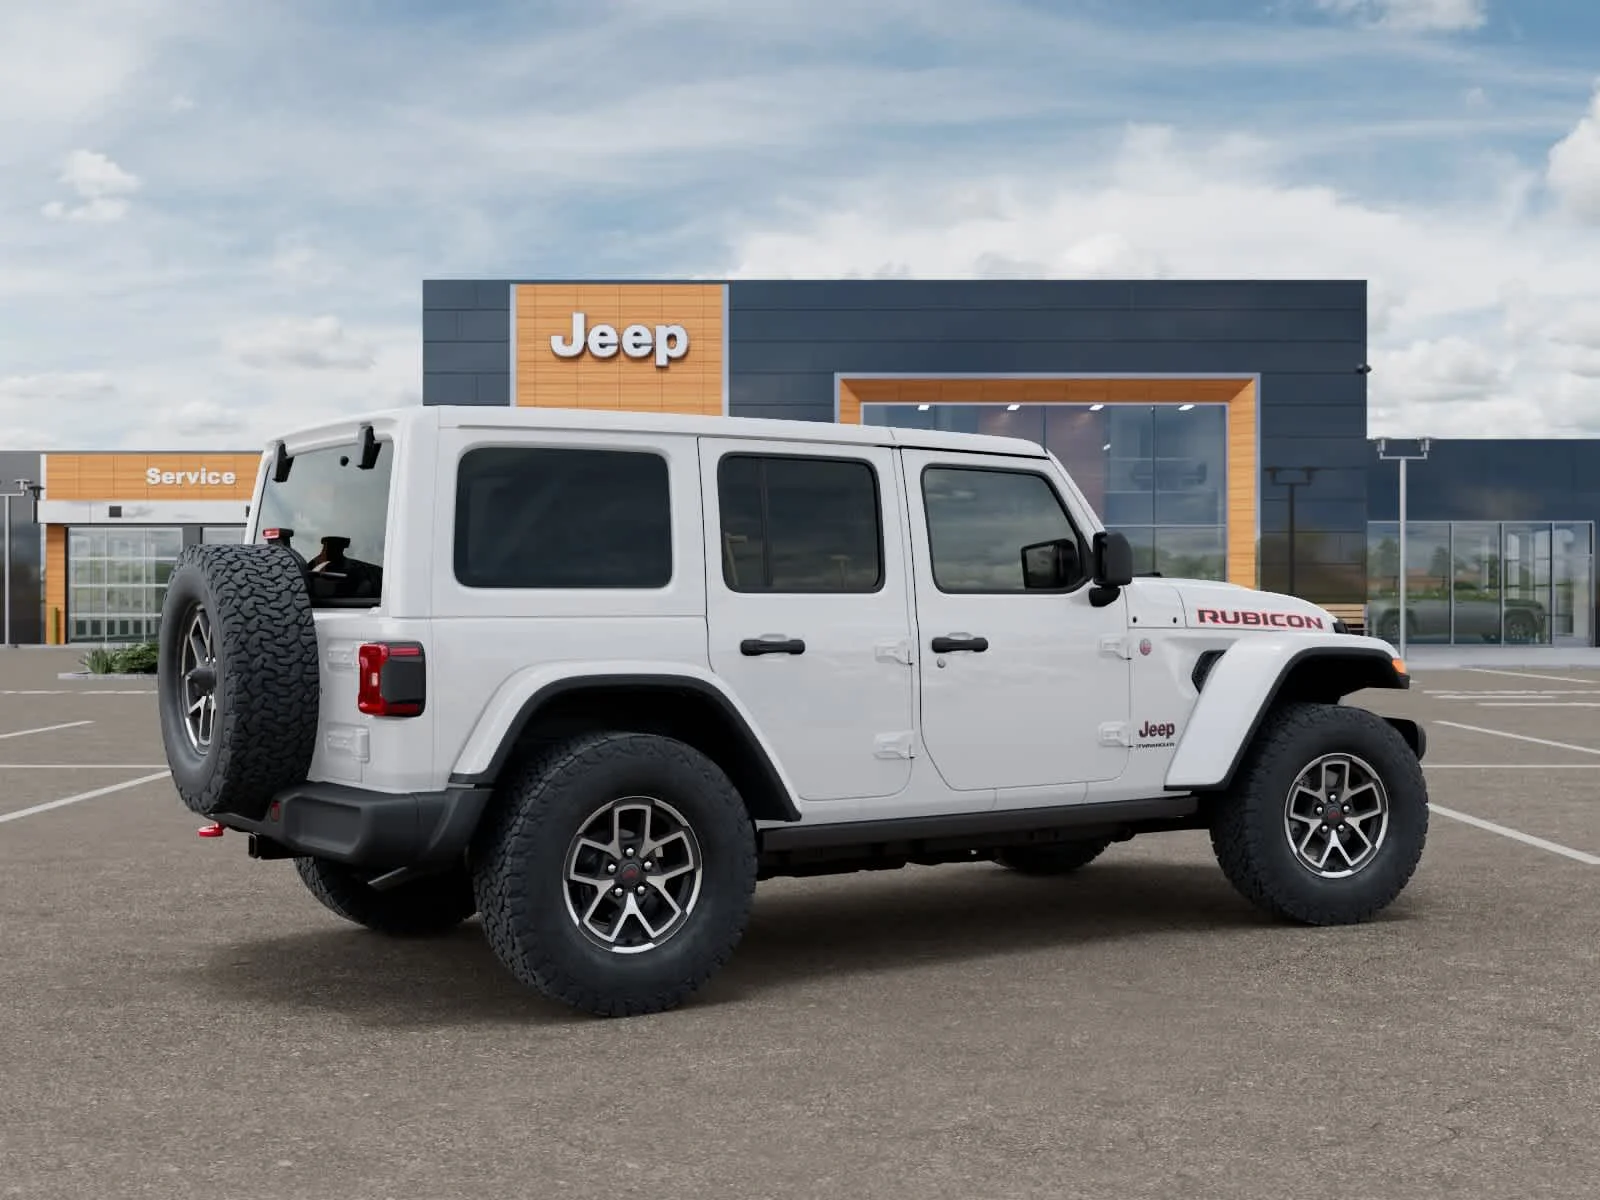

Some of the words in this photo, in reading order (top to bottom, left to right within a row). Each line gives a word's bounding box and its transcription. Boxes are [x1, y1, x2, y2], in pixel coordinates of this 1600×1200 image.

[550, 312, 690, 368] Jeep
[146, 466, 236, 486] Service
[1198, 608, 1324, 630] RUBICON
[1138, 720, 1175, 739] Jeep
